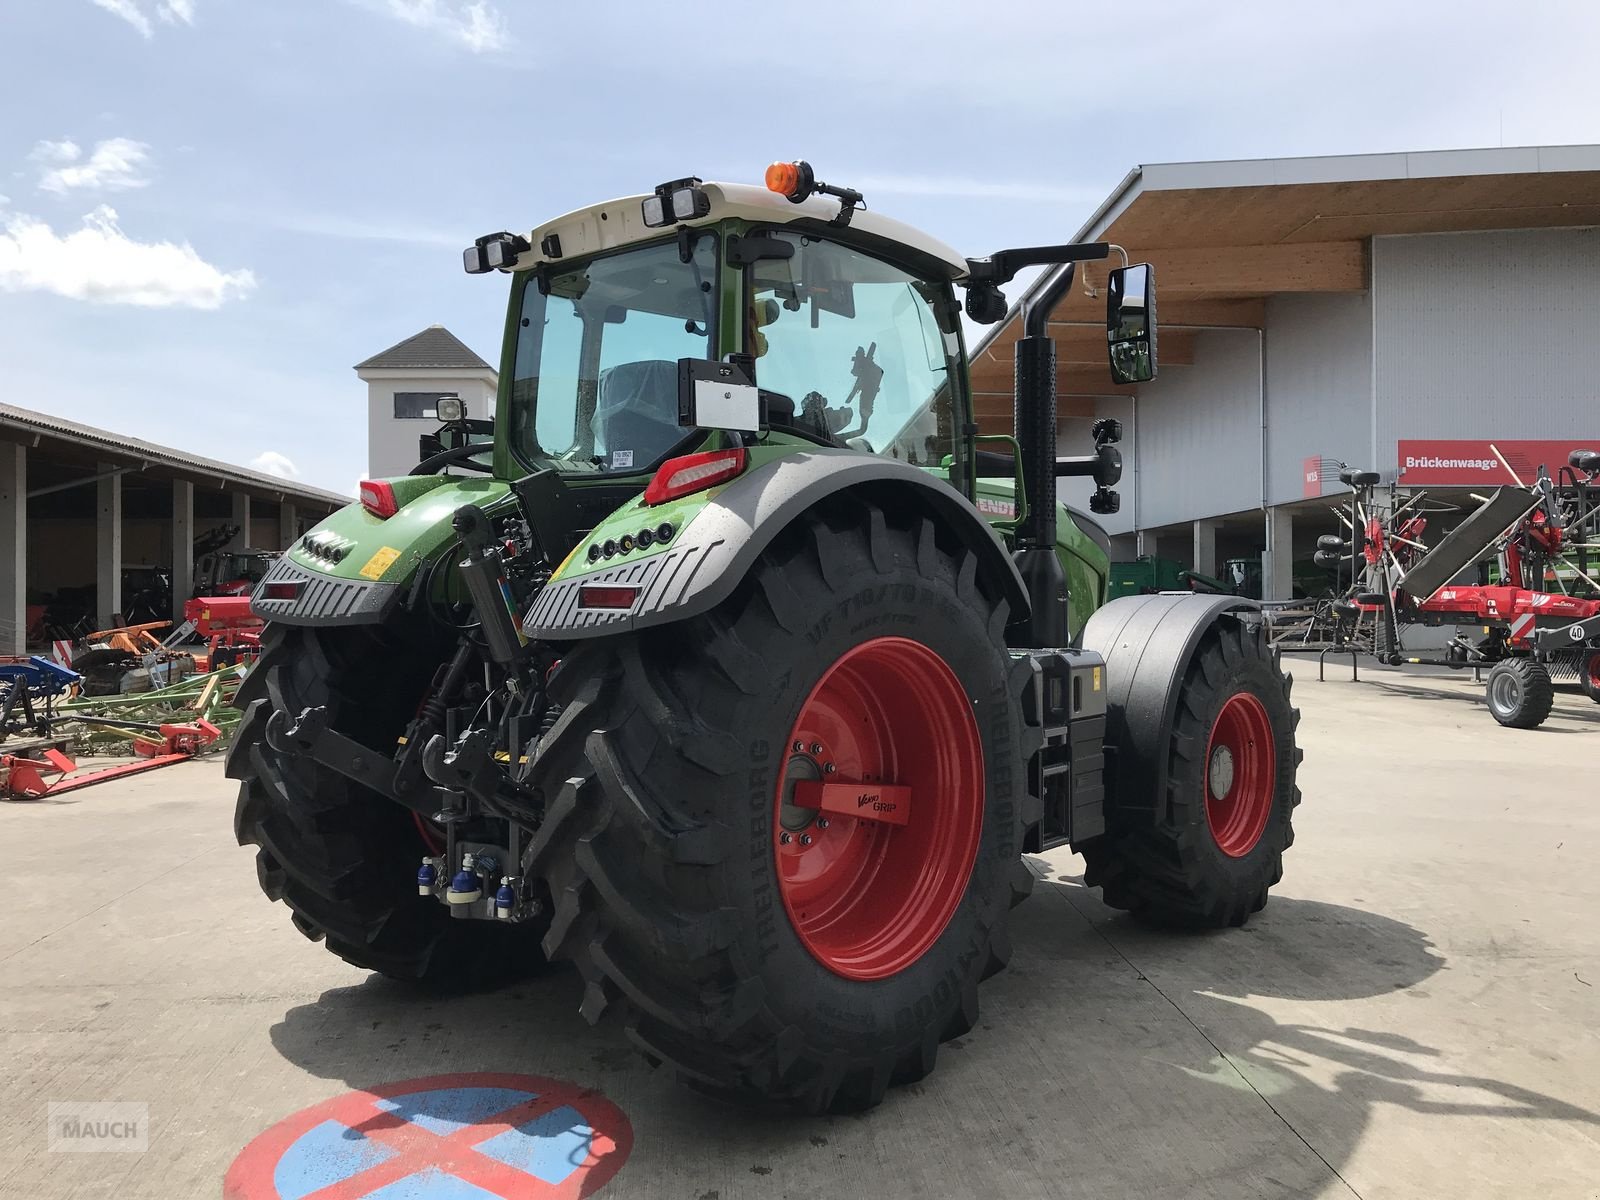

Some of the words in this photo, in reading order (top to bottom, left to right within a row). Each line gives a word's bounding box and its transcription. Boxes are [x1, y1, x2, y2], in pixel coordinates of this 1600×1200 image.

[1406, 456, 1498, 471] Brückenwaage
[1571, 628, 1583, 639] 40
[873, 801, 897, 812] GRIP
[749, 739, 778, 957] TRELLEBORG
